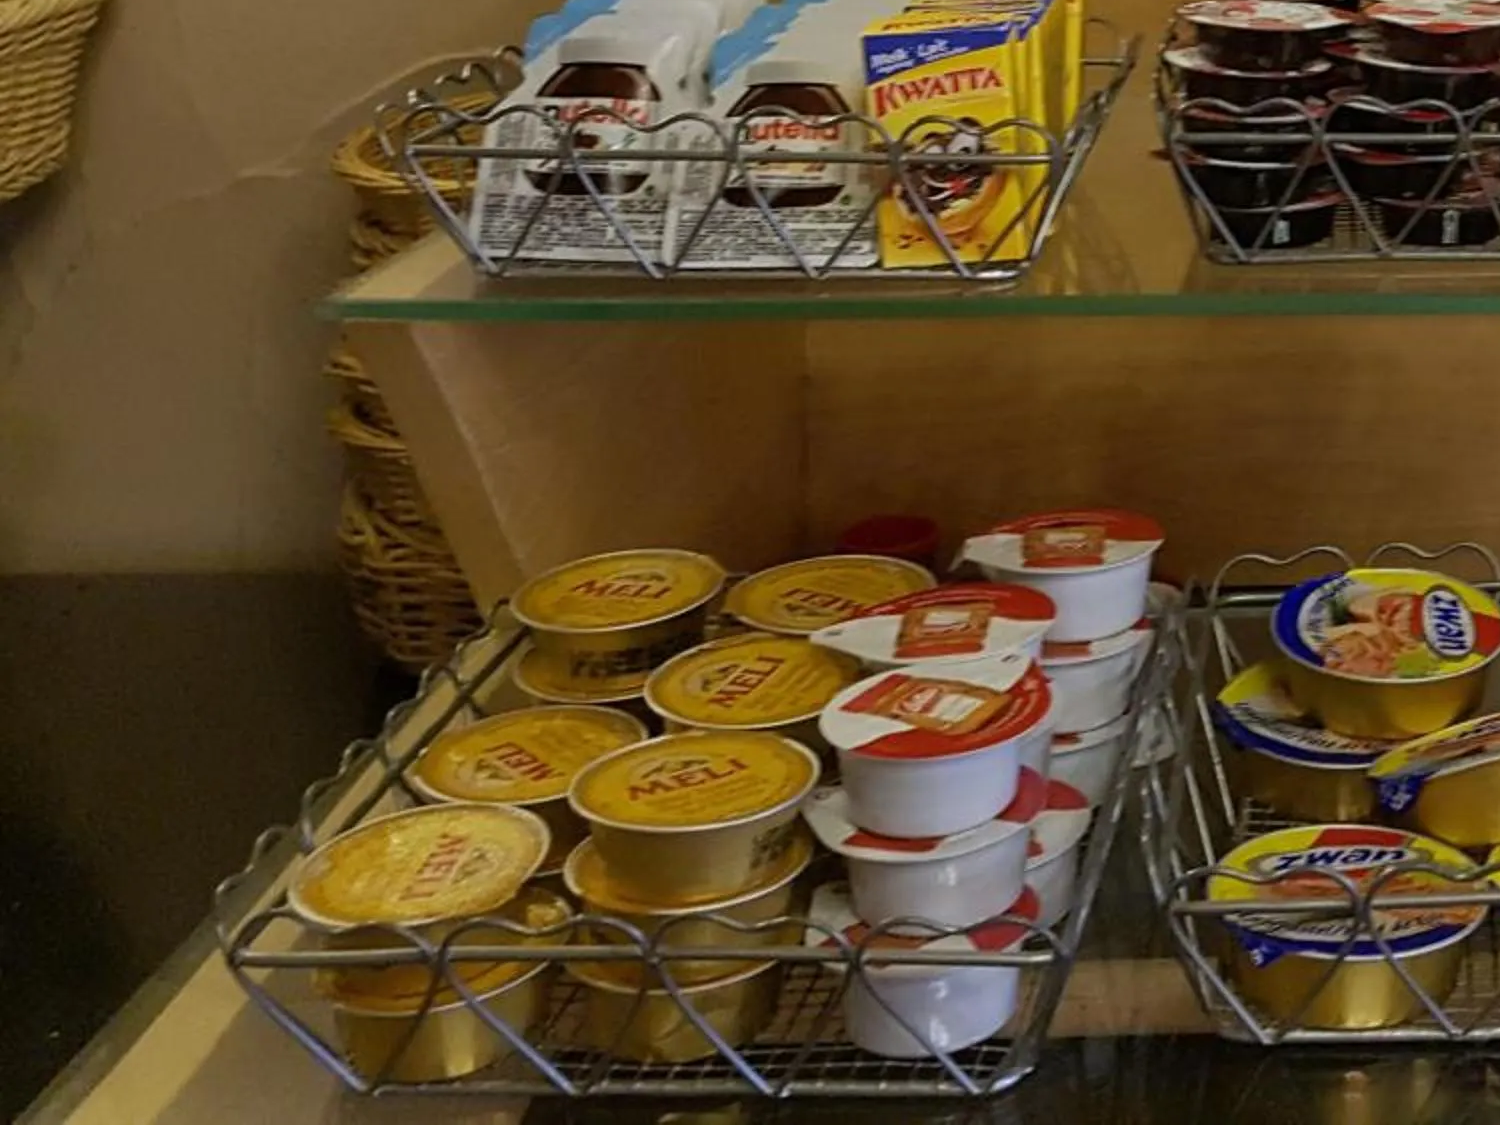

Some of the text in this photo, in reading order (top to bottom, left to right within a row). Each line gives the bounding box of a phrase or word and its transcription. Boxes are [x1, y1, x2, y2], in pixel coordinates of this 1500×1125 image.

[873, 67, 1005, 119] KWATTA
[571, 578, 673, 600] MELI
[708, 655, 788, 709] MELI
[484, 741, 566, 782] MELI
[628, 757, 750, 802] MELI
